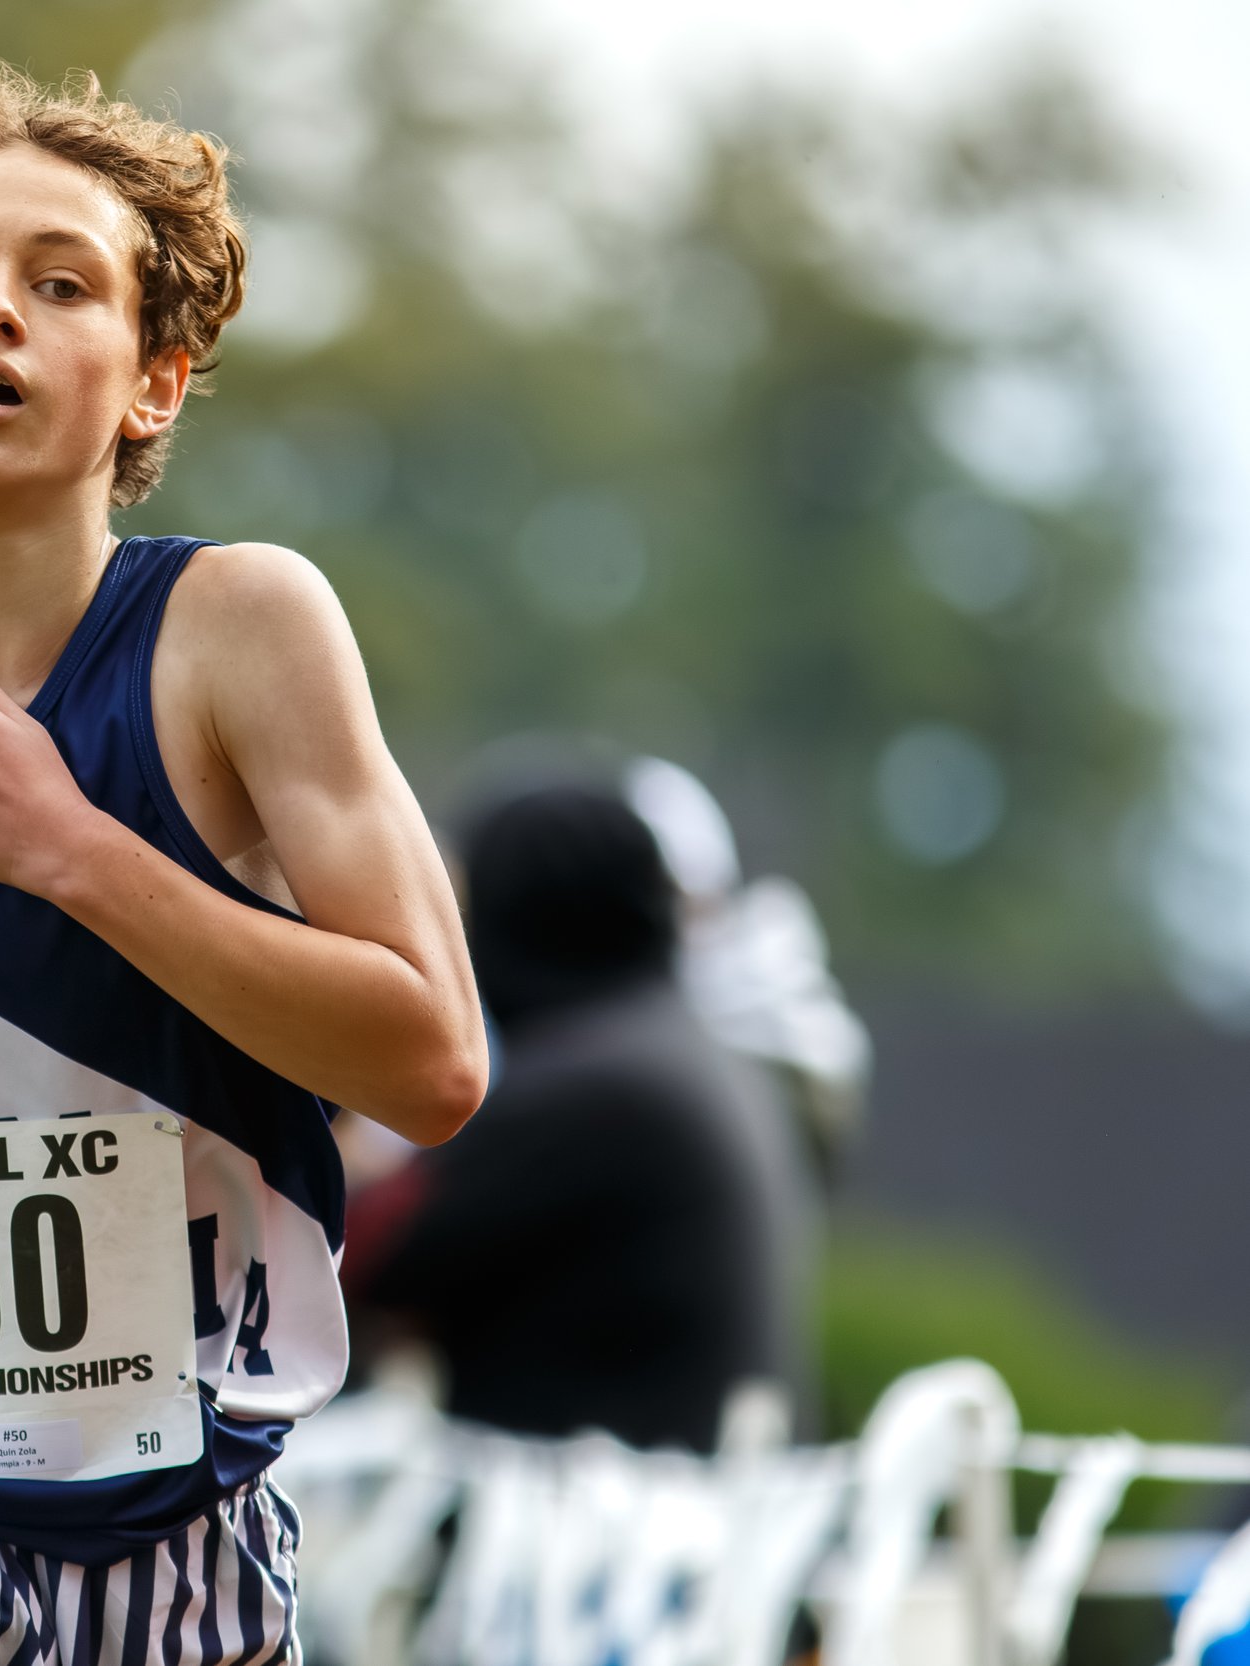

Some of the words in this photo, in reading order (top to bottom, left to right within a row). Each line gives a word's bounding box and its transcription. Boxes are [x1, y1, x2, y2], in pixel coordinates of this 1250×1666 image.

[40, 1130, 120, 1179] XC
[3, 1430, 28, 1442] #50
[135, 1431, 162, 1456] 50
[18, 1447, 37, 1455] Zola
[37, 1458, 46, 1466] M
